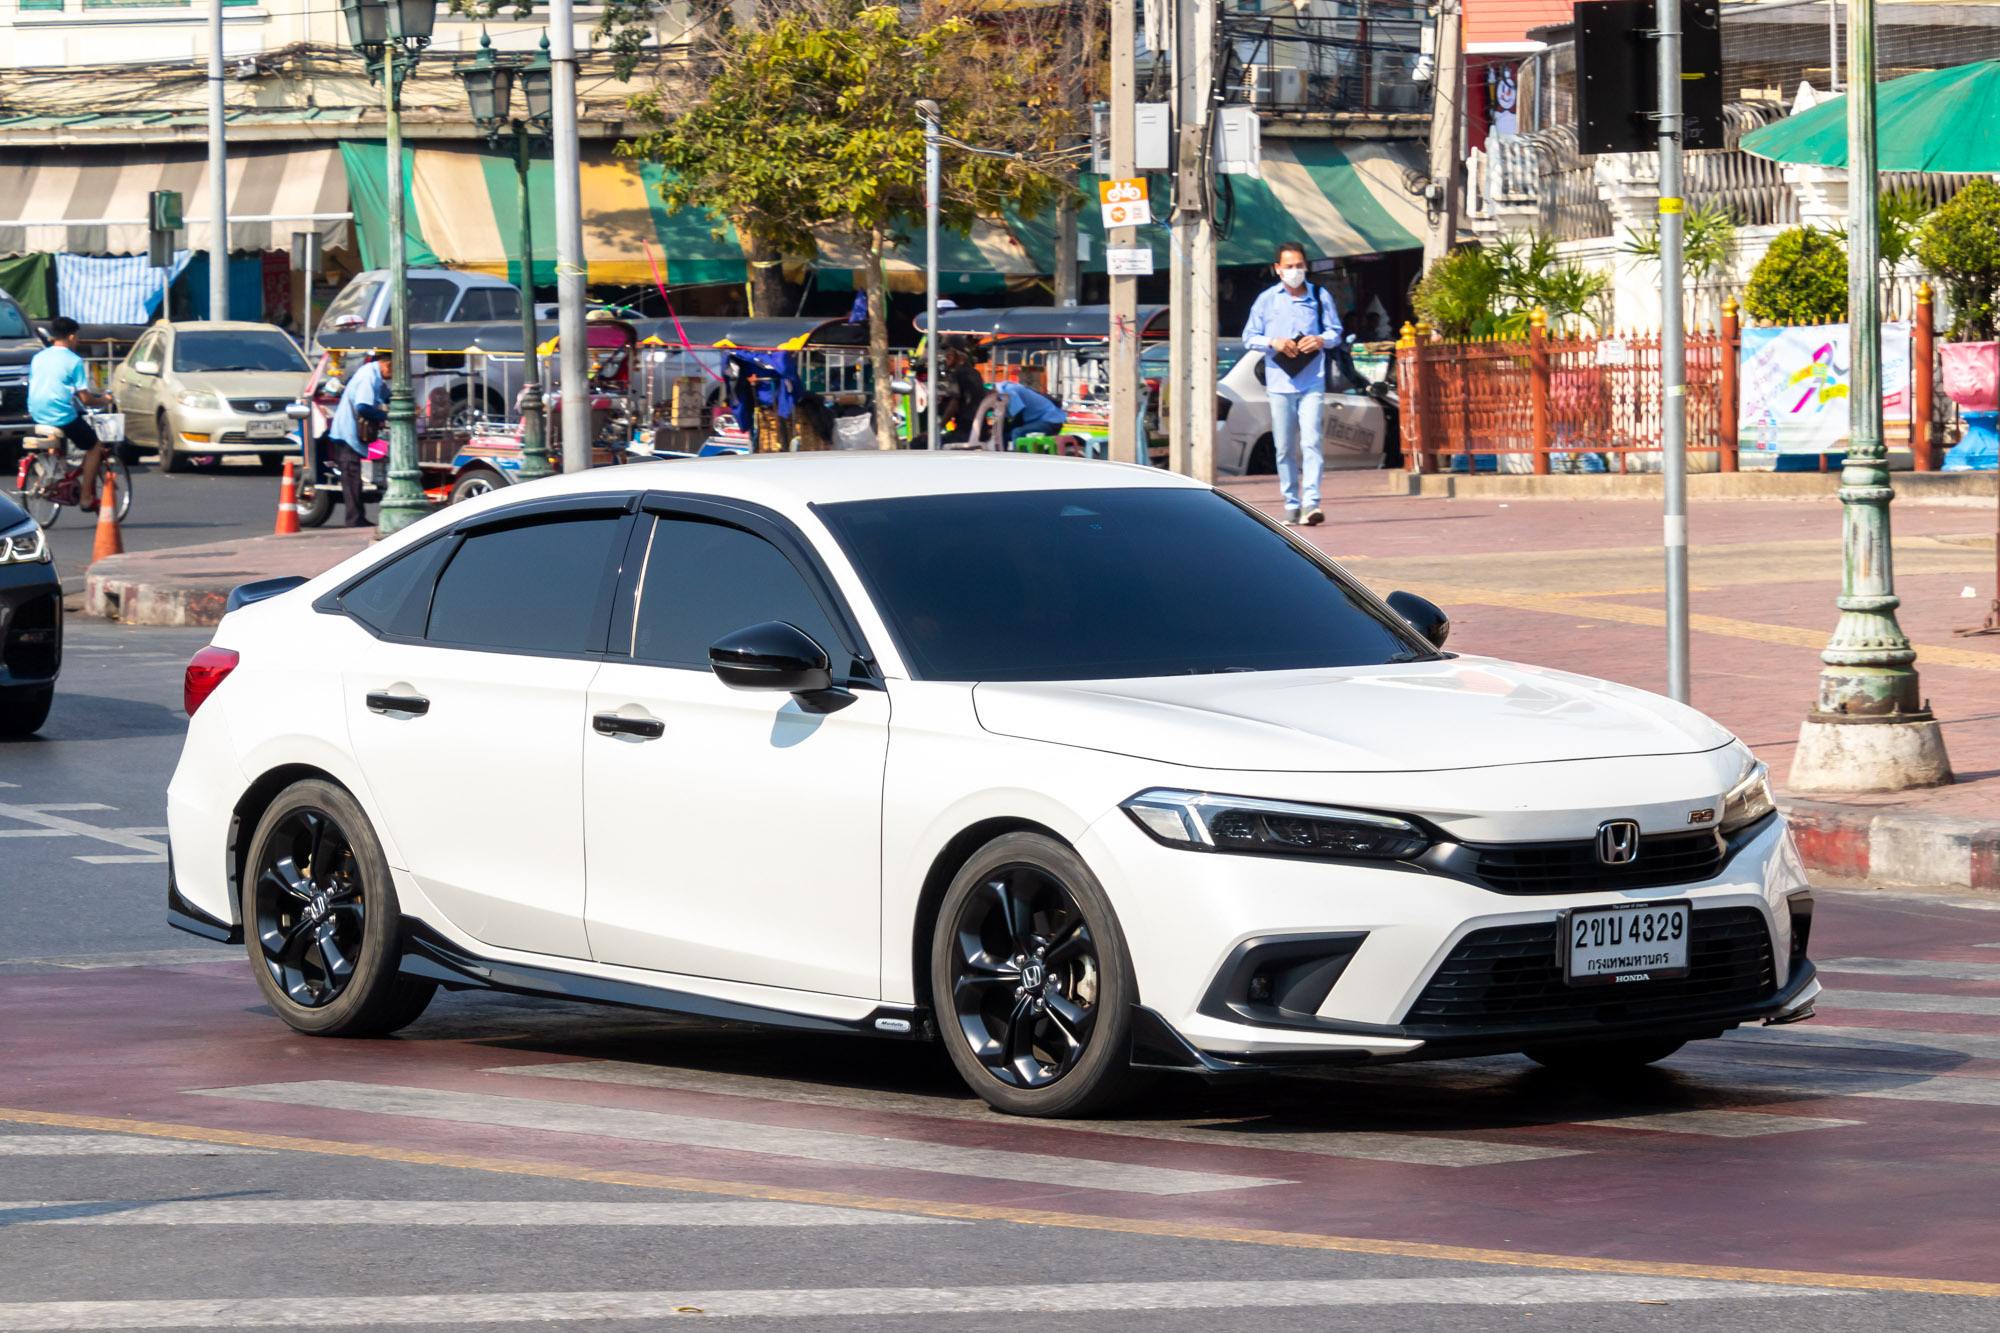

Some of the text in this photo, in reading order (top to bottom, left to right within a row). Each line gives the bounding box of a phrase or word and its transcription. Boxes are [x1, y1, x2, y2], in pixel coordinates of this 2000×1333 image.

[1628, 911, 1683, 943] 4329
[1588, 952, 1669, 975] กรุงเทพมหานคร
[1615, 973, 1650, 983] HONDA
